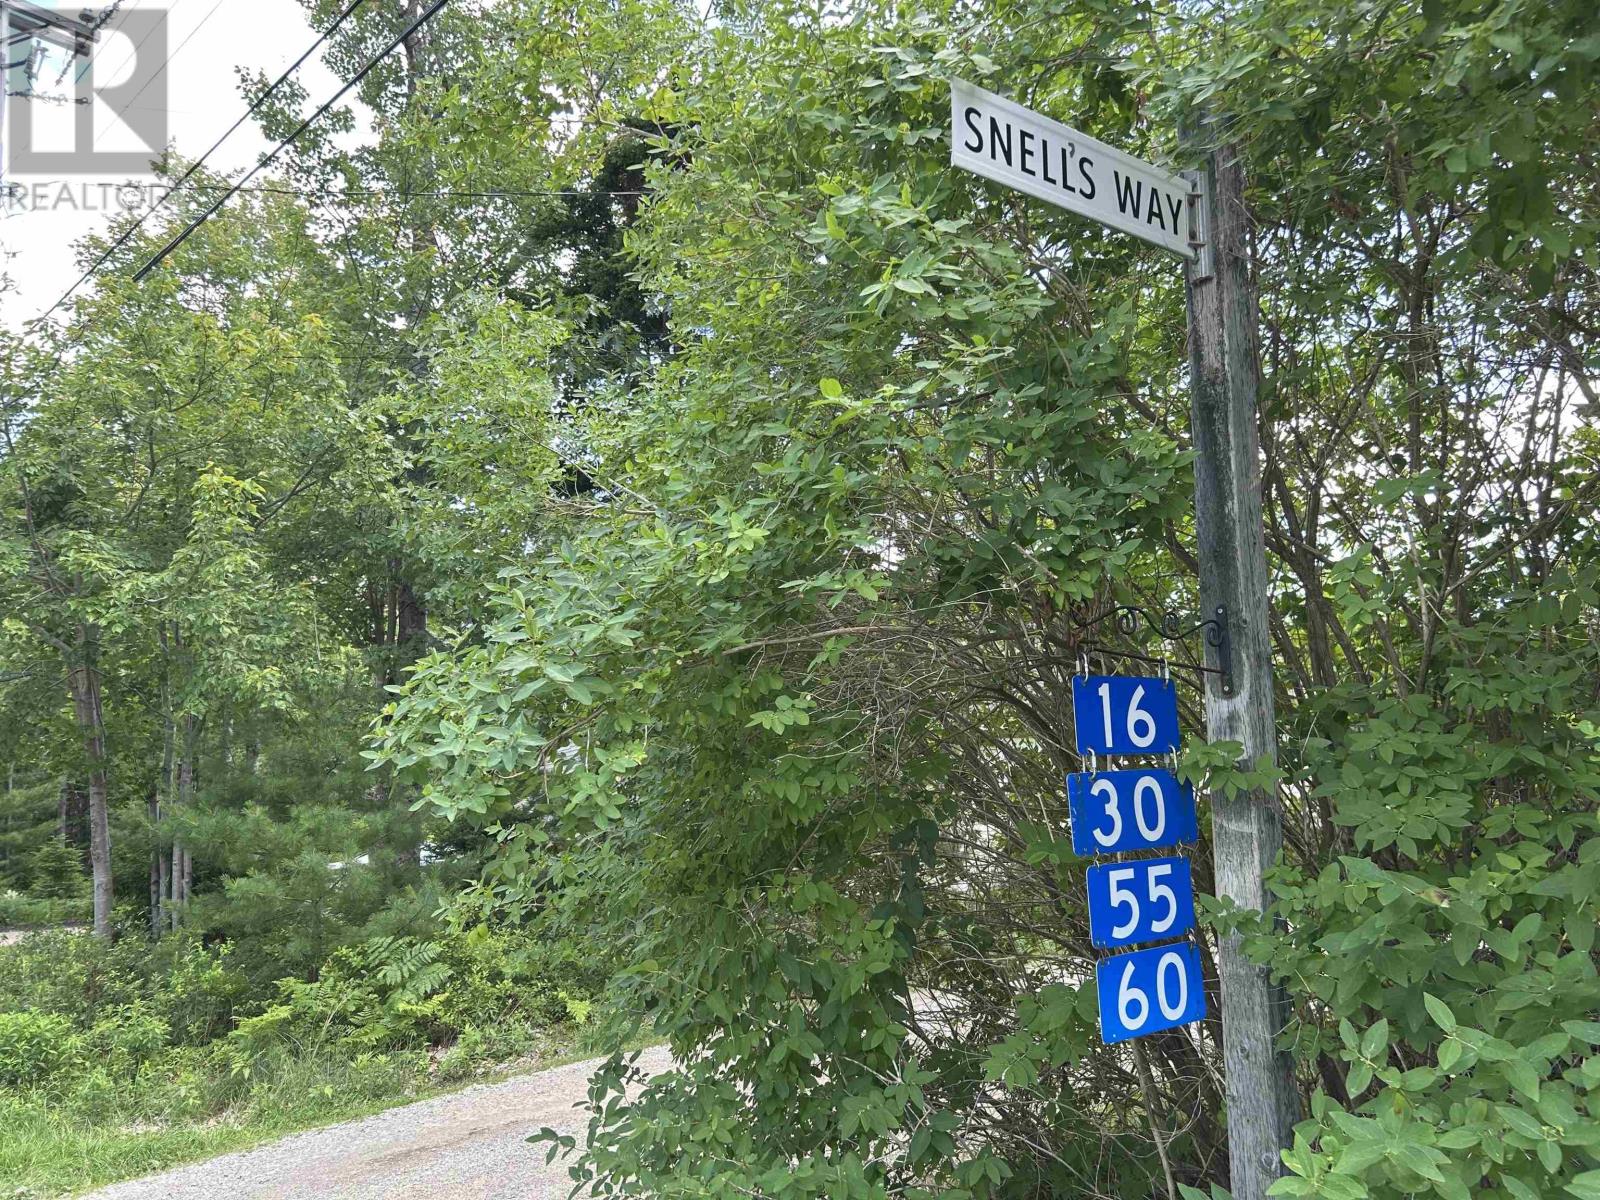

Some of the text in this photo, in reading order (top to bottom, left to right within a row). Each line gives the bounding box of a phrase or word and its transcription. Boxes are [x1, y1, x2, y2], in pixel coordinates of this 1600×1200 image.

[964, 106, 1183, 235] SNELL'S WAY
[1098, 682, 1156, 748] 16
[1090, 775, 1166, 847] 30
[1108, 863, 1177, 939] 55
[1118, 951, 1188, 1031] 60
